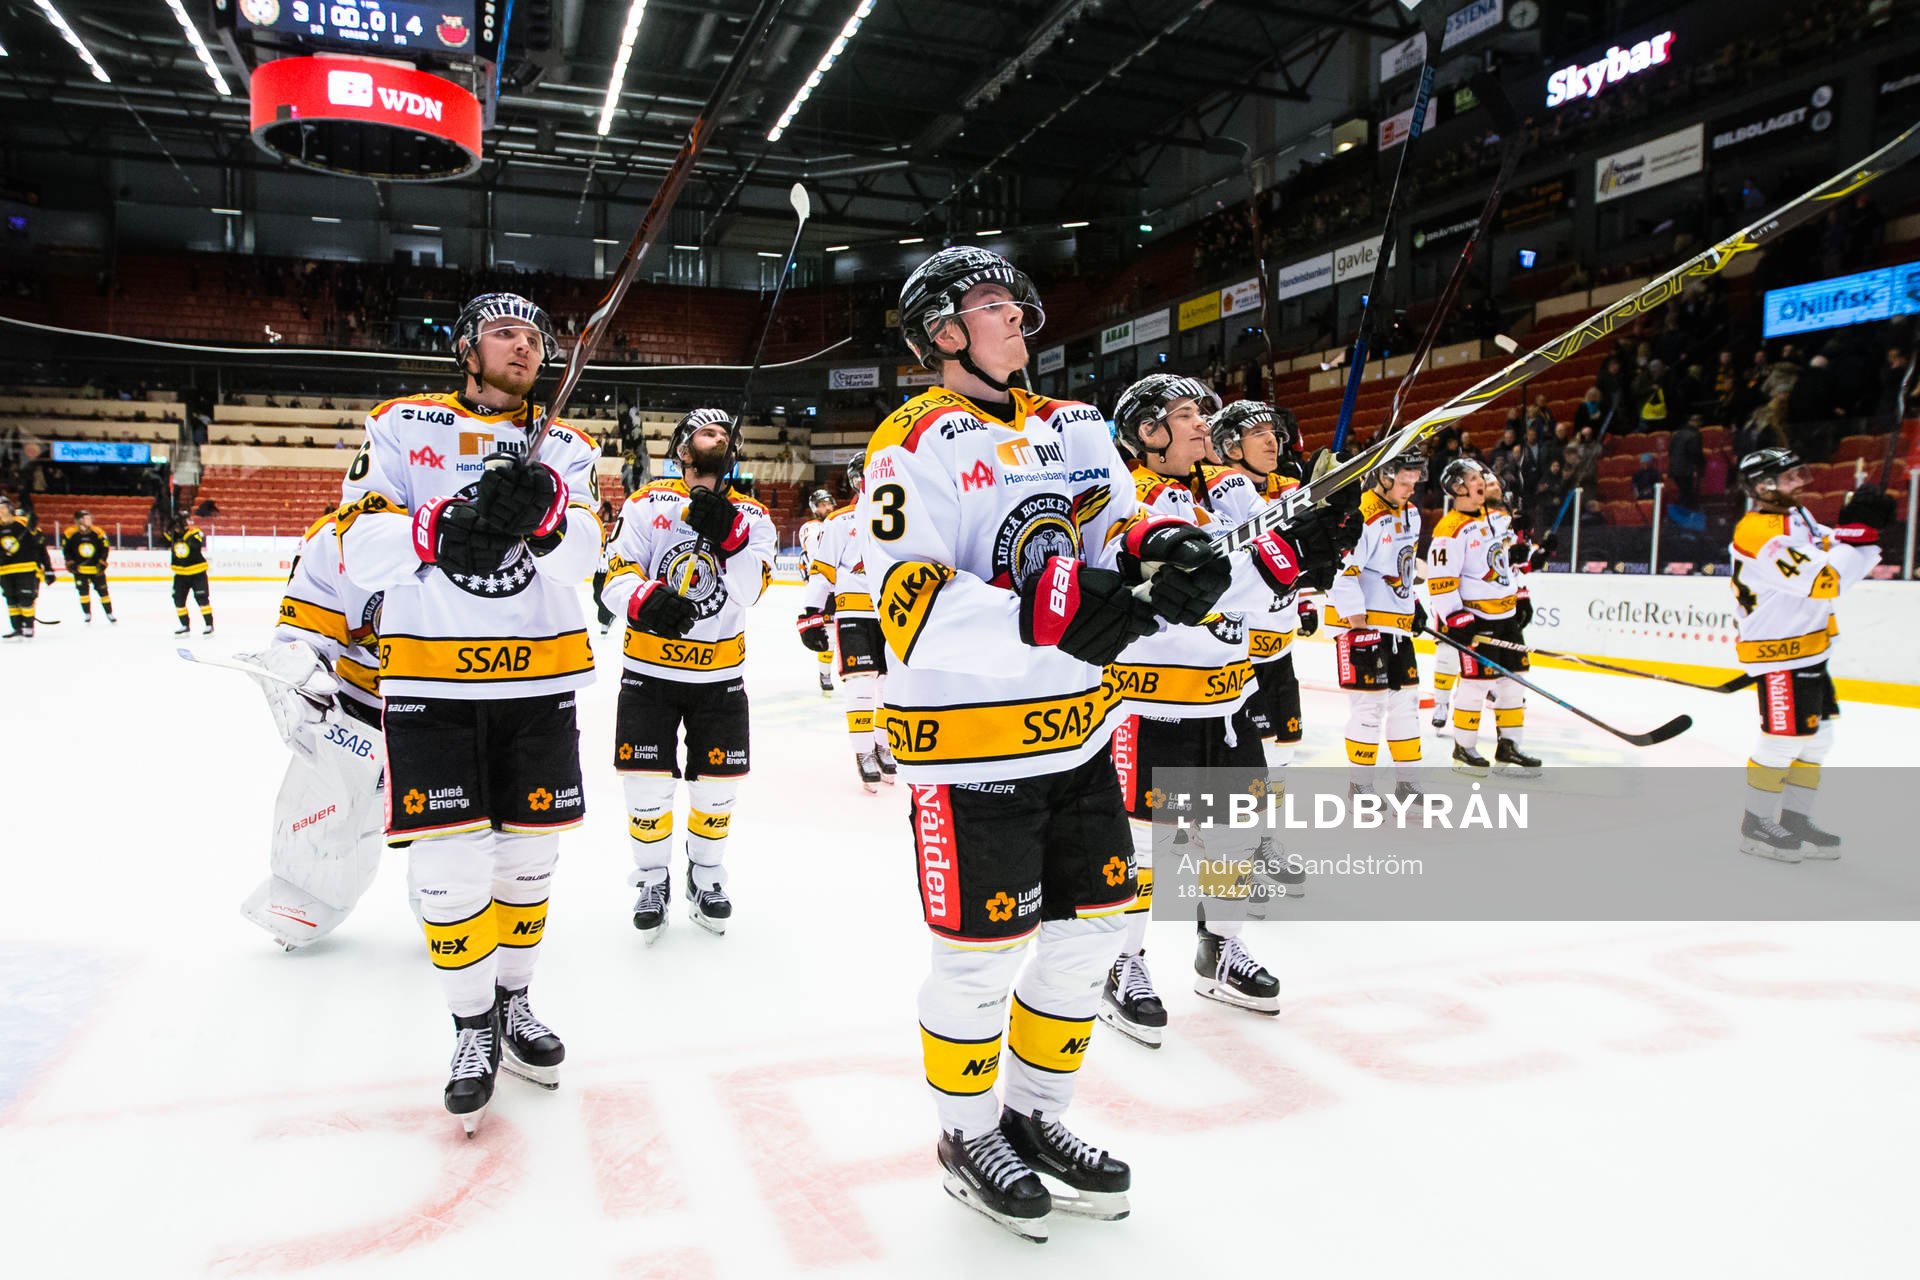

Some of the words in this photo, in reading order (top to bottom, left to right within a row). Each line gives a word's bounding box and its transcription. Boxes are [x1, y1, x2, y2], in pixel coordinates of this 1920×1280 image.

[405, 15, 424, 36] 4
[1546, 31, 1676, 108] Skybar
[377, 87, 443, 122] WDN
[1712, 106, 1808, 149] BILBOLAGET
[1337, 246, 1380, 277] gavle.
[1280, 266, 1331, 289] Handelsbanken
[1799, 287, 1877, 322] Nilfisk
[839, 371, 873, 381] Caravan
[417, 409, 455, 426] LKAB
[893, 394, 954, 429] SSAB
[1064, 409, 1102, 425] LKAB
[549, 426, 573, 444] KAB
[409, 445, 447, 470] MAX
[1068, 467, 1111, 485] SCANI
[871, 484, 907, 542] 3
[997, 515, 1023, 566] LULEÅ
[1020, 497, 1072, 517] HOCKEY
[1431, 548, 1448, 567] 14
[1775, 546, 1812, 579] 44
[1252, 635, 1283, 652] SSA
[1756, 641, 1801, 660] SSAB
[456, 645, 531, 674] SSAB
[659, 643, 715, 666] SSAB
[387, 703, 426, 713] BAUER
[323, 723, 374, 758] SSAB
[726, 757, 748, 765] Energ
[429, 785, 463, 800] Luleå
[955, 781, 1016, 795] BAUER
[429, 797, 470, 810] Energi
[555, 796, 581, 810] Energ
[292, 804, 337, 833] BAUER
[632, 816, 660, 831] NEX
[703, 816, 731, 829] NEX
[1018, 894, 1042, 917] Energ
[431, 935, 470, 955] NEX
[1060, 1036, 1091, 1055] NE
